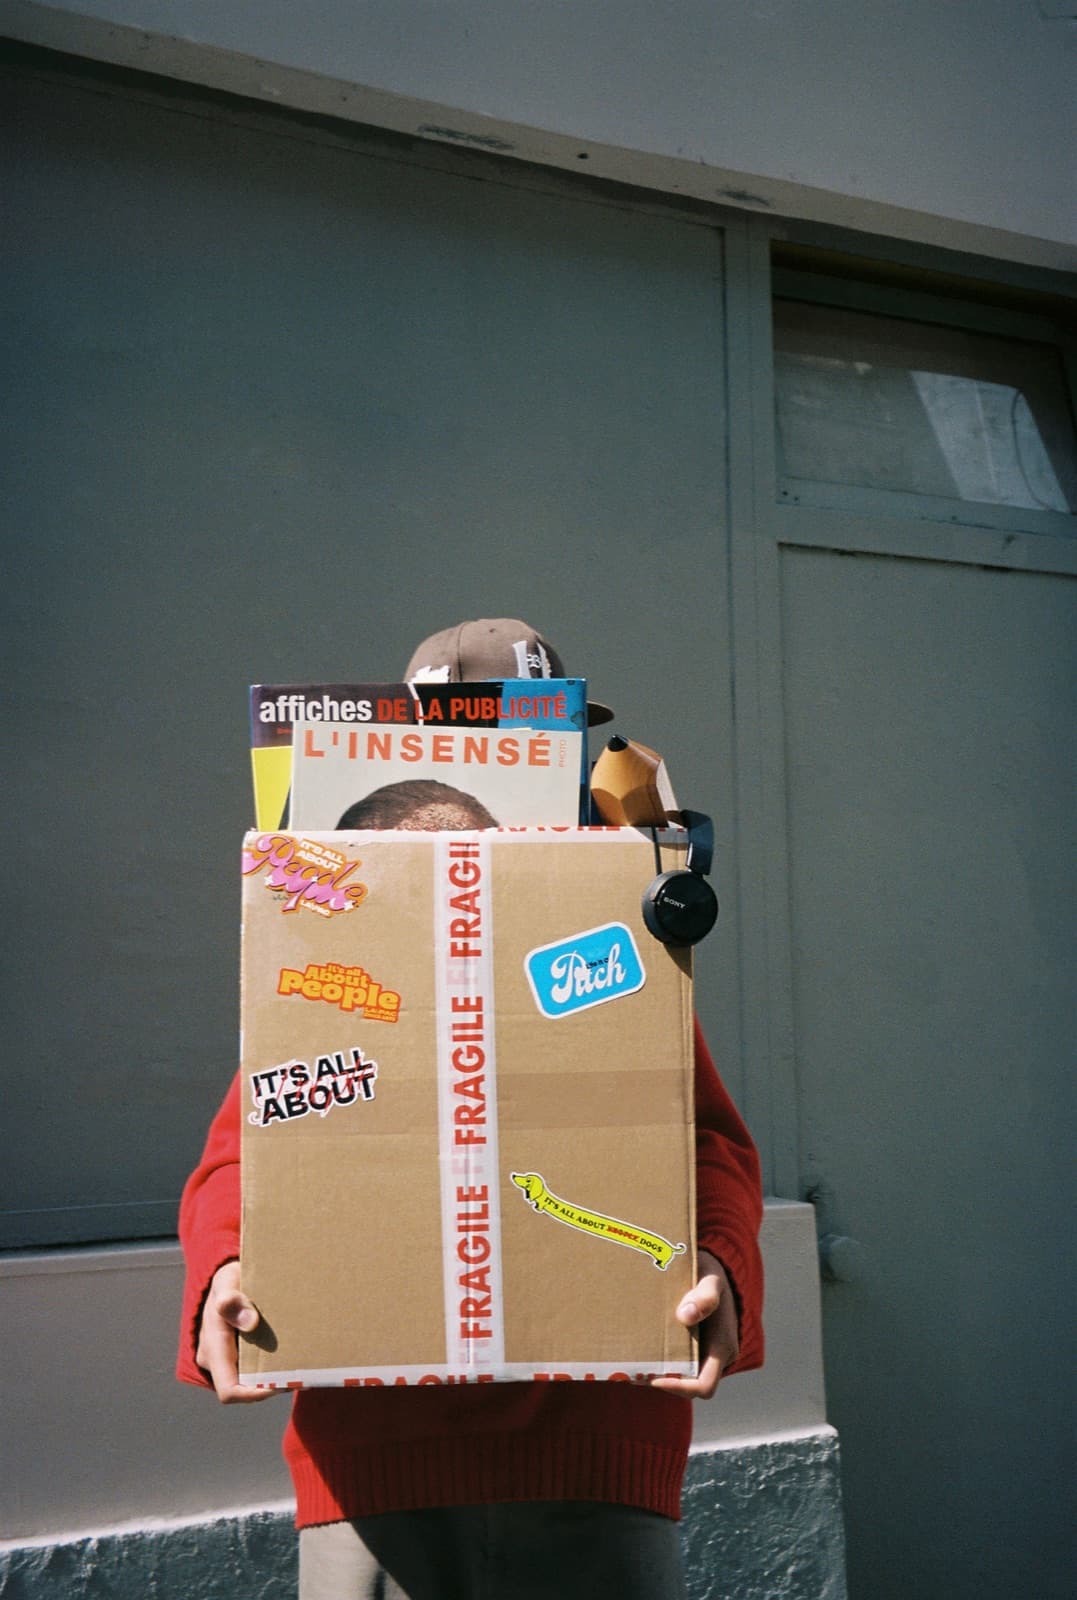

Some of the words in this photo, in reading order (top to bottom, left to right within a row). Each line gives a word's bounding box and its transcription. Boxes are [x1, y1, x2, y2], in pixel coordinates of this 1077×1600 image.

[259, 695, 372, 722] affiches
[377, 698, 408, 720] DE
[414, 698, 444, 720] LA
[449, 691, 568, 719] PUBLICITÉ
[304, 729, 551, 767] L'INSENSÉ
[295, 850, 341, 872] ABOUT
[663, 896, 686, 910] SONY
[305, 966, 369, 989] About
[252, 1064, 309, 1097] IT'S
[317, 1050, 373, 1082] ALL
[451, 996, 487, 1144] FRAGILE
[262, 1072, 375, 1125] ABOUT
[560, 1208, 575, 1219] ALL
[576, 1216, 606, 1230] ABOUT
[639, 1238, 664, 1253] DOGS
[456, 1185, 493, 1339] FRAGILE
